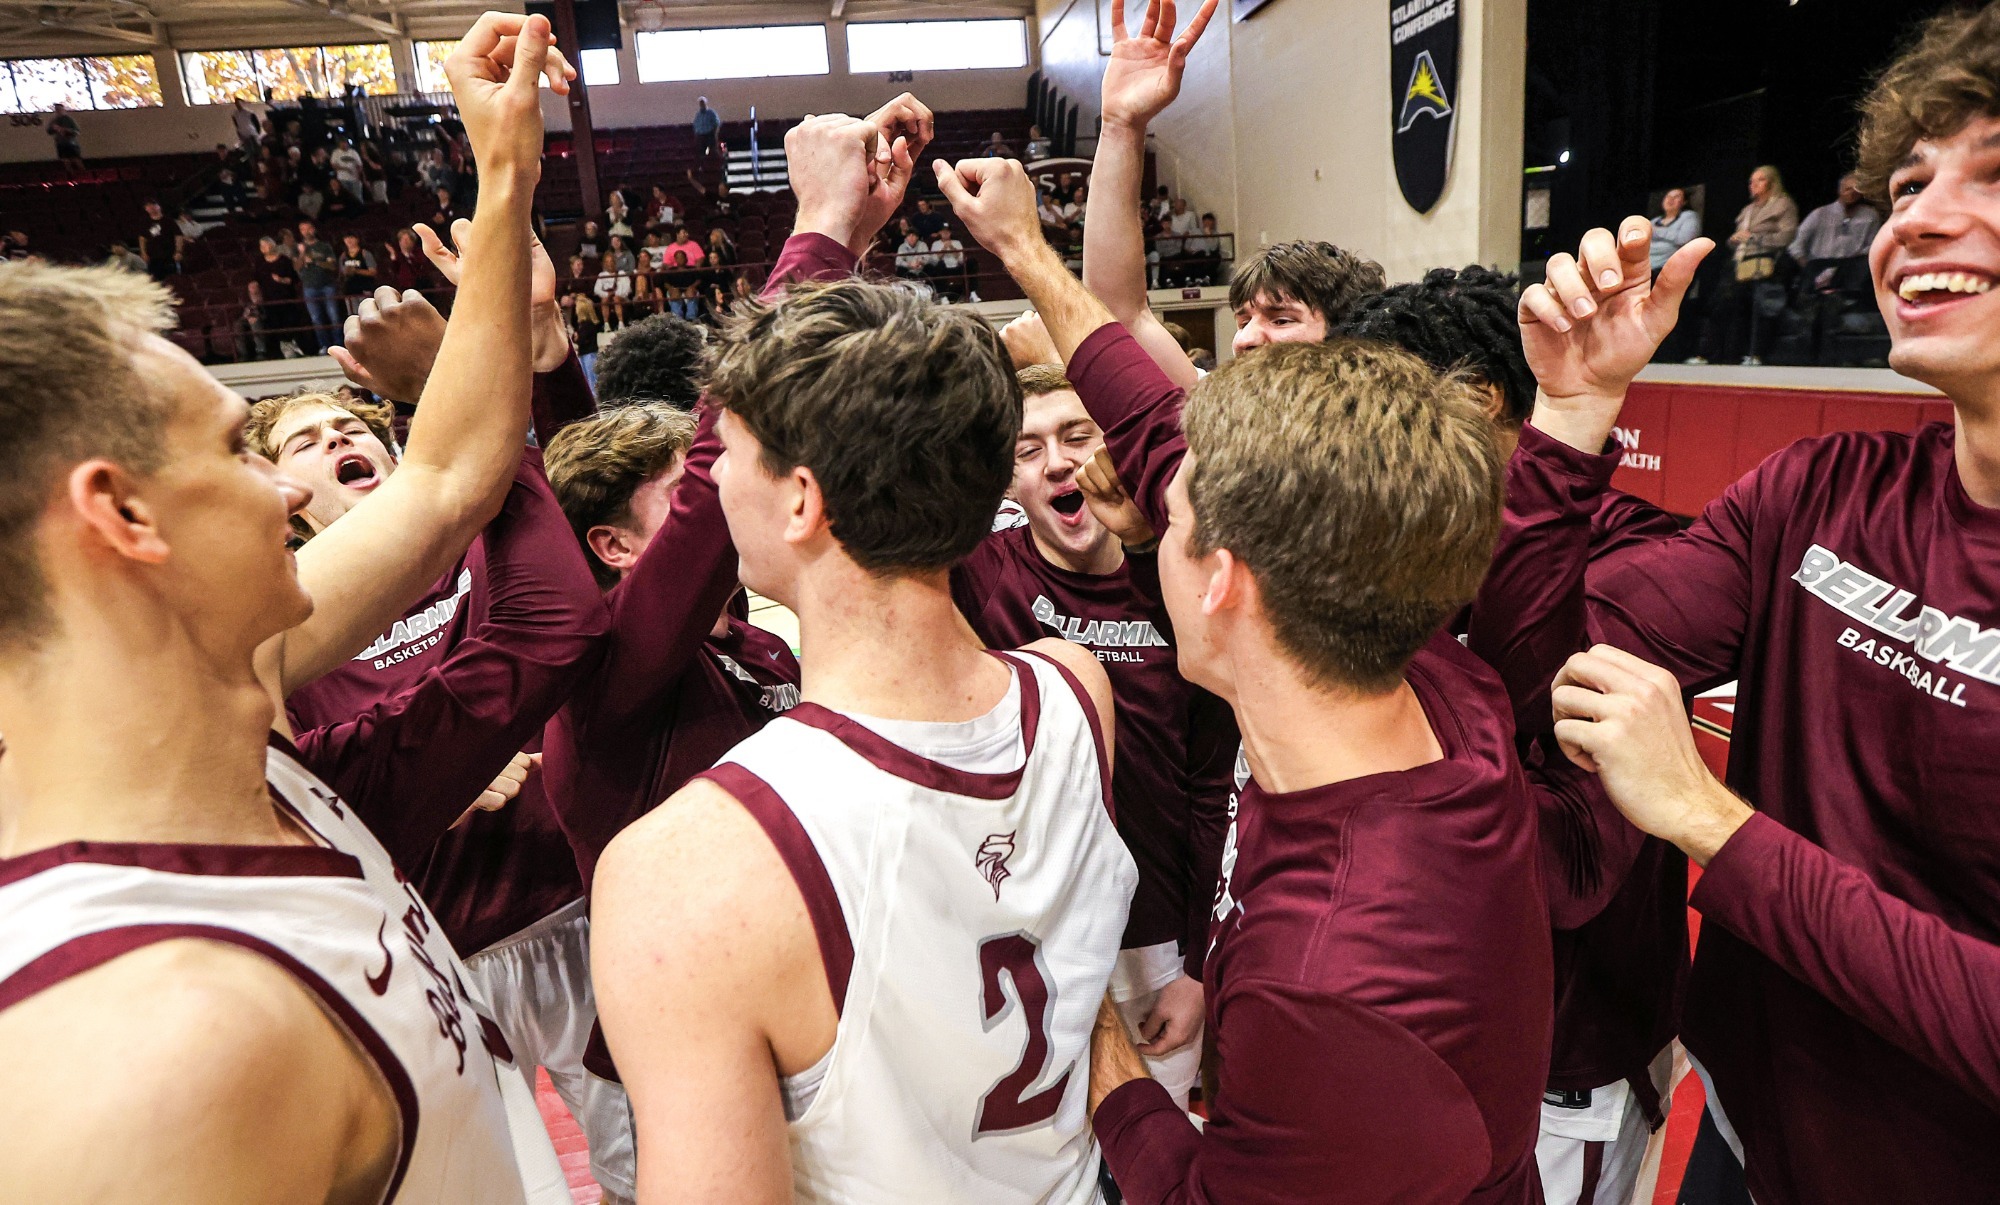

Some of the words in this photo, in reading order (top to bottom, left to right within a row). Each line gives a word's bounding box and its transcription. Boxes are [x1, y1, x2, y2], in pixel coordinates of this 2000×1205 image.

[1392, 0, 1456, 46] CONFERENCE
[1619, 452, 1661, 471] ALTH
[972, 928, 1076, 1143] 2
